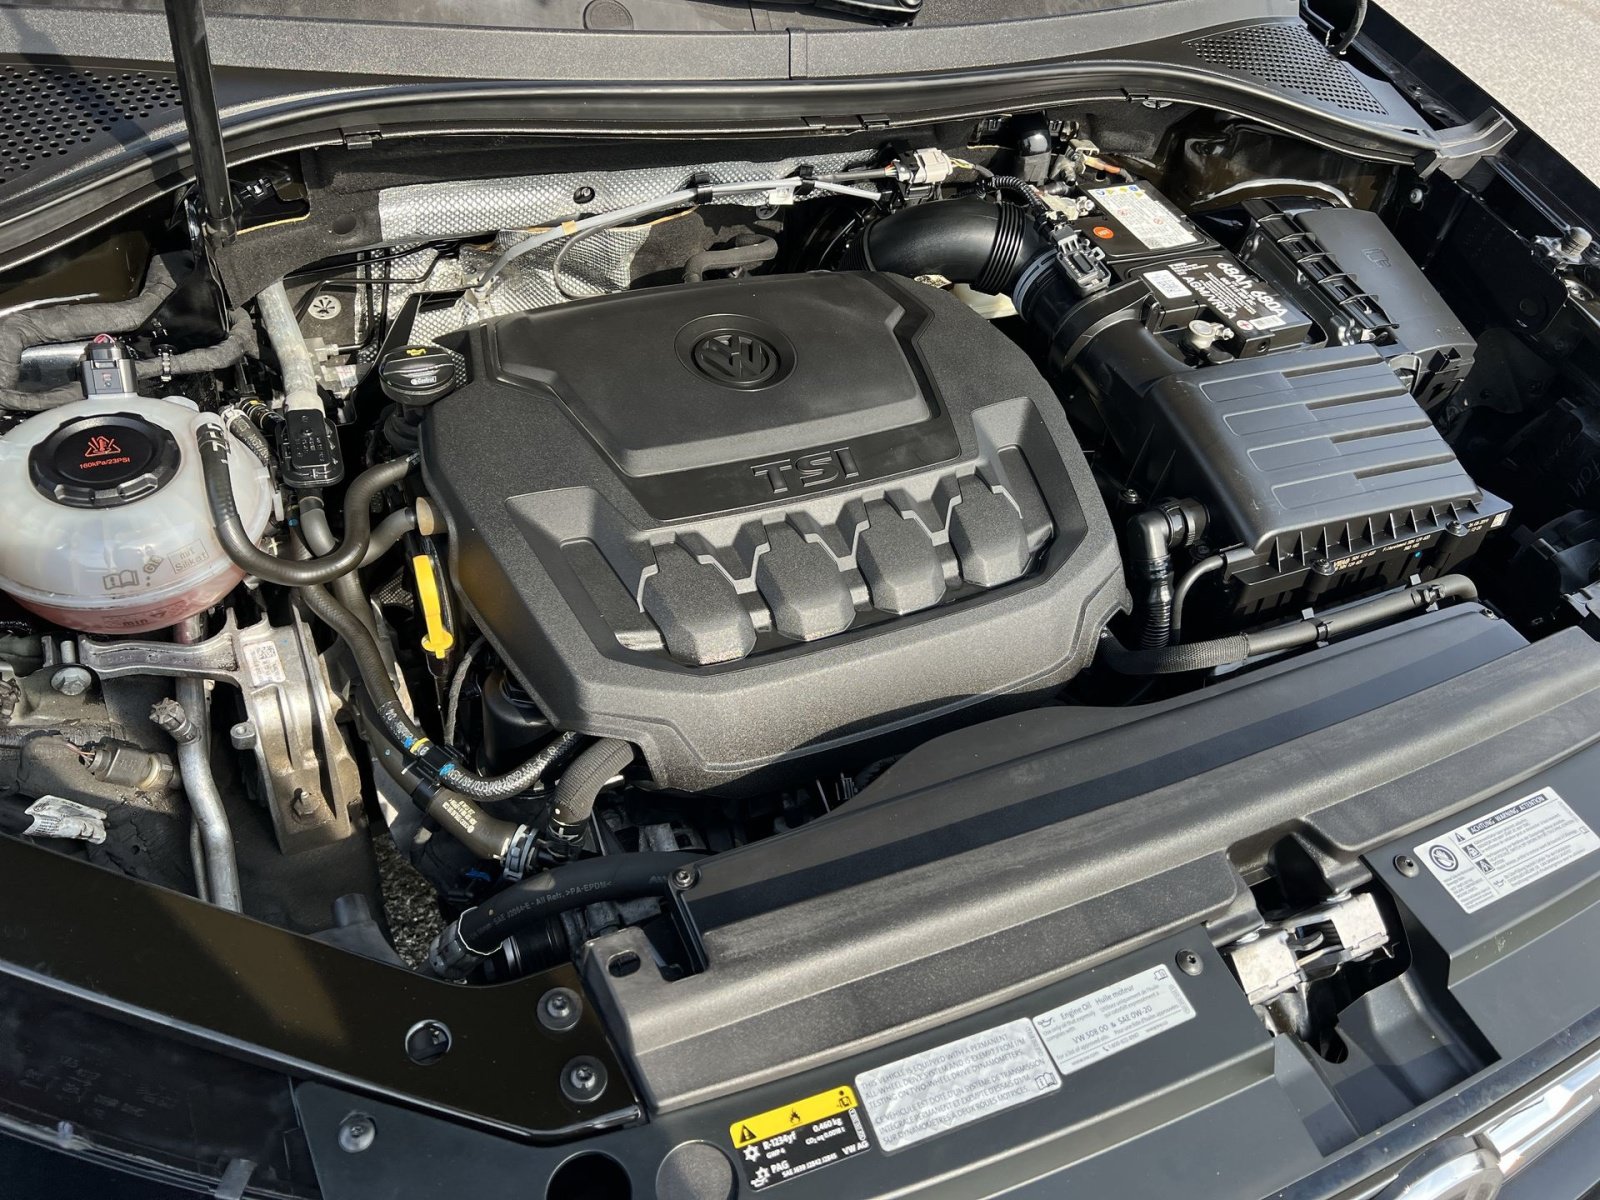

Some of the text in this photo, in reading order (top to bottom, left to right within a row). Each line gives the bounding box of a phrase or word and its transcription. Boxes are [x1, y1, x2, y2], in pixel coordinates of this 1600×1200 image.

[1182, 276, 1237, 319] AGM/VRLA
[1217, 262, 1253, 288] 68Ah
[1251, 290, 1288, 316] 680A
[79, 457, 131, 471] 160kPa/23PSI
[750, 447, 860, 494] TSI
[122, 619, 148, 627] min
[1469, 794, 1545, 833] ACHTUNG WARNING ATTENTION
[1094, 984, 1135, 1006] Huile moteur
[1060, 1001, 1092, 1020] Engine Oil
[1071, 1033, 1085, 1044] VW
[1084, 1027, 1099, 1038] 508
[1098, 1023, 1109, 1032] 00
[1117, 1013, 1131, 1024] SAE
[1130, 1004, 1152, 1019] 0W-20
[861, 1079, 877, 1090] THIS
[877, 1069, 904, 1084] VEHICLE
[912, 1054, 946, 1072] EQUIPPED
[945, 1048, 964, 1060] WITH
[969, 1033, 1008, 1052] PERMANENT
[902, 1073, 923, 1085] DRIVE
[923, 1064, 948, 1078] SYSTEM
[970, 1048, 995, 1062] EXEMPT
[999, 1057, 1045, 1079] TRANSMISSION
[867, 1092, 898, 1109] TESTING
[897, 1088, 910, 1098] ON
[950, 1066, 971, 1080] DRIVE
[811, 1116, 843, 1134] 0.460 kg
[761, 1132, 798, 1152] R-1234yf
[841, 1139, 868, 1155] VW AG
[882, 1132, 898, 1144] SUR
[765, 1149, 781, 1159] GWP
[770, 1159, 790, 1174] PAG
[781, 1168, 793, 1178] SAE
